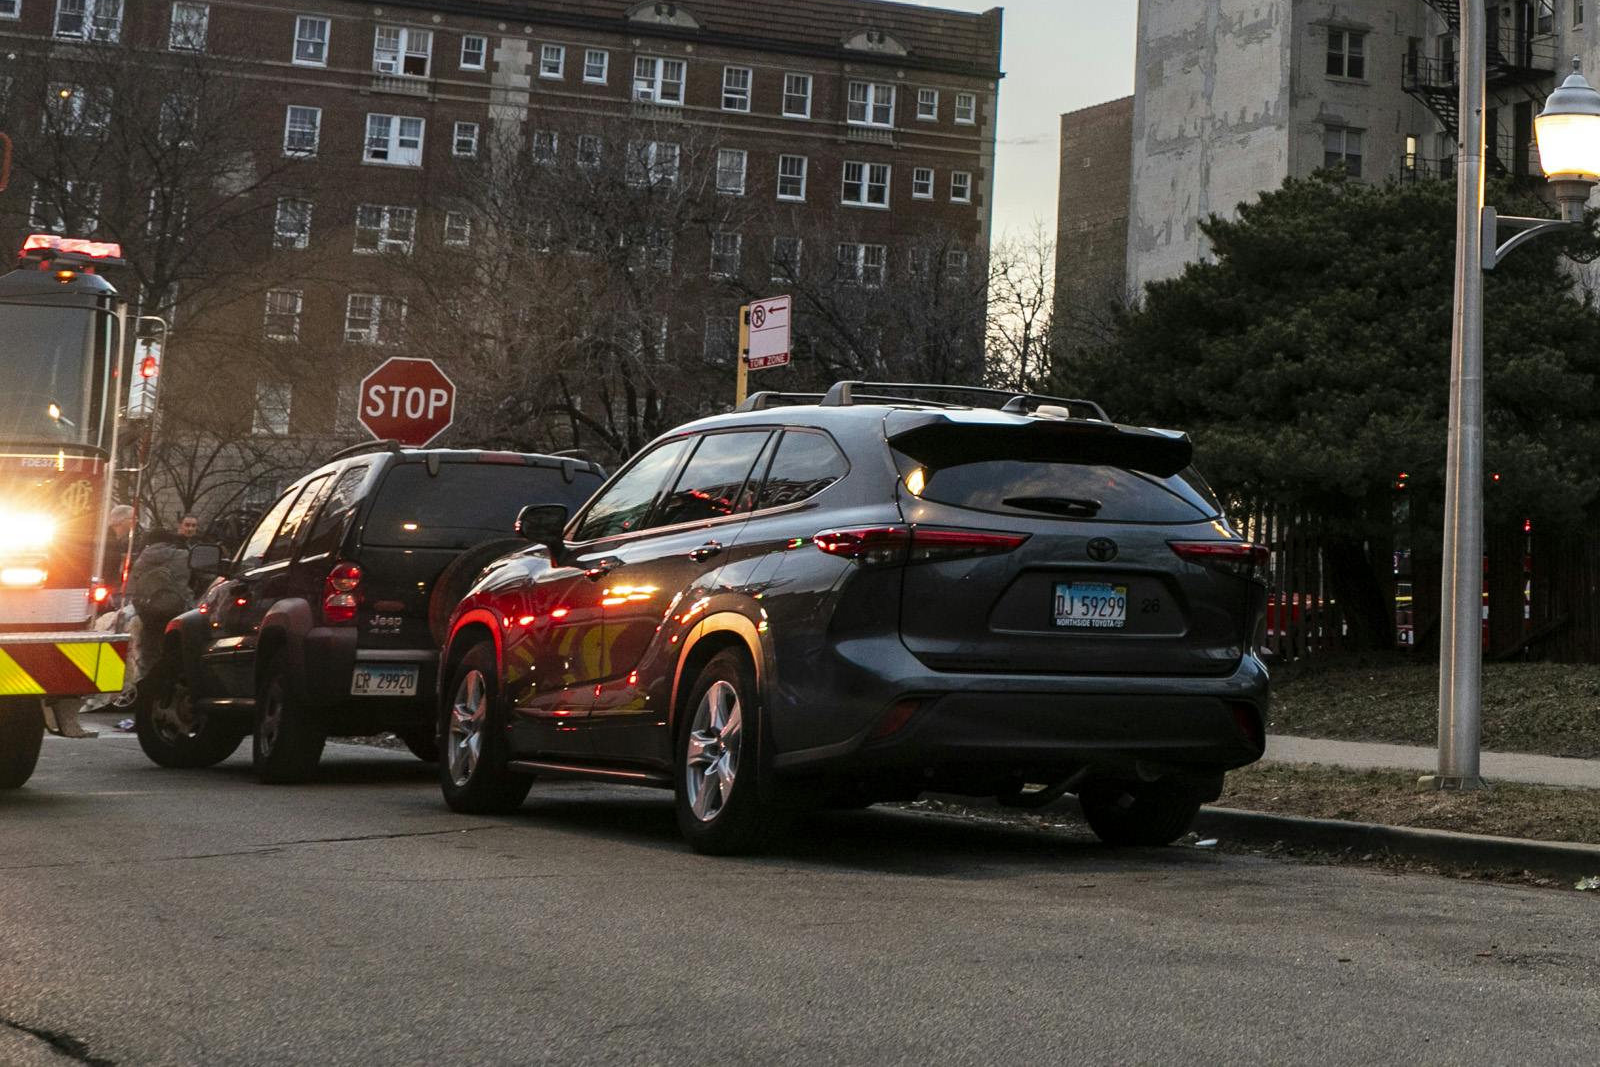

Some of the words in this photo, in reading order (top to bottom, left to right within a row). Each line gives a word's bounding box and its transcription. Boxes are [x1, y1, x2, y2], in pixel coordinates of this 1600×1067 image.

[750, 358, 764, 368] TOW
[767, 354, 786, 365] ZONE
[366, 385, 448, 419] STOP
[1056, 595, 1074, 616] DJ
[1081, 596, 1125, 617] 59299
[1141, 598, 1161, 614] 26
[369, 614, 402, 627] Jeep
[1056, 618, 1090, 628] NORTHSIDE
[1092, 619, 1114, 628] TOYOTA
[355, 672, 371, 689] CR
